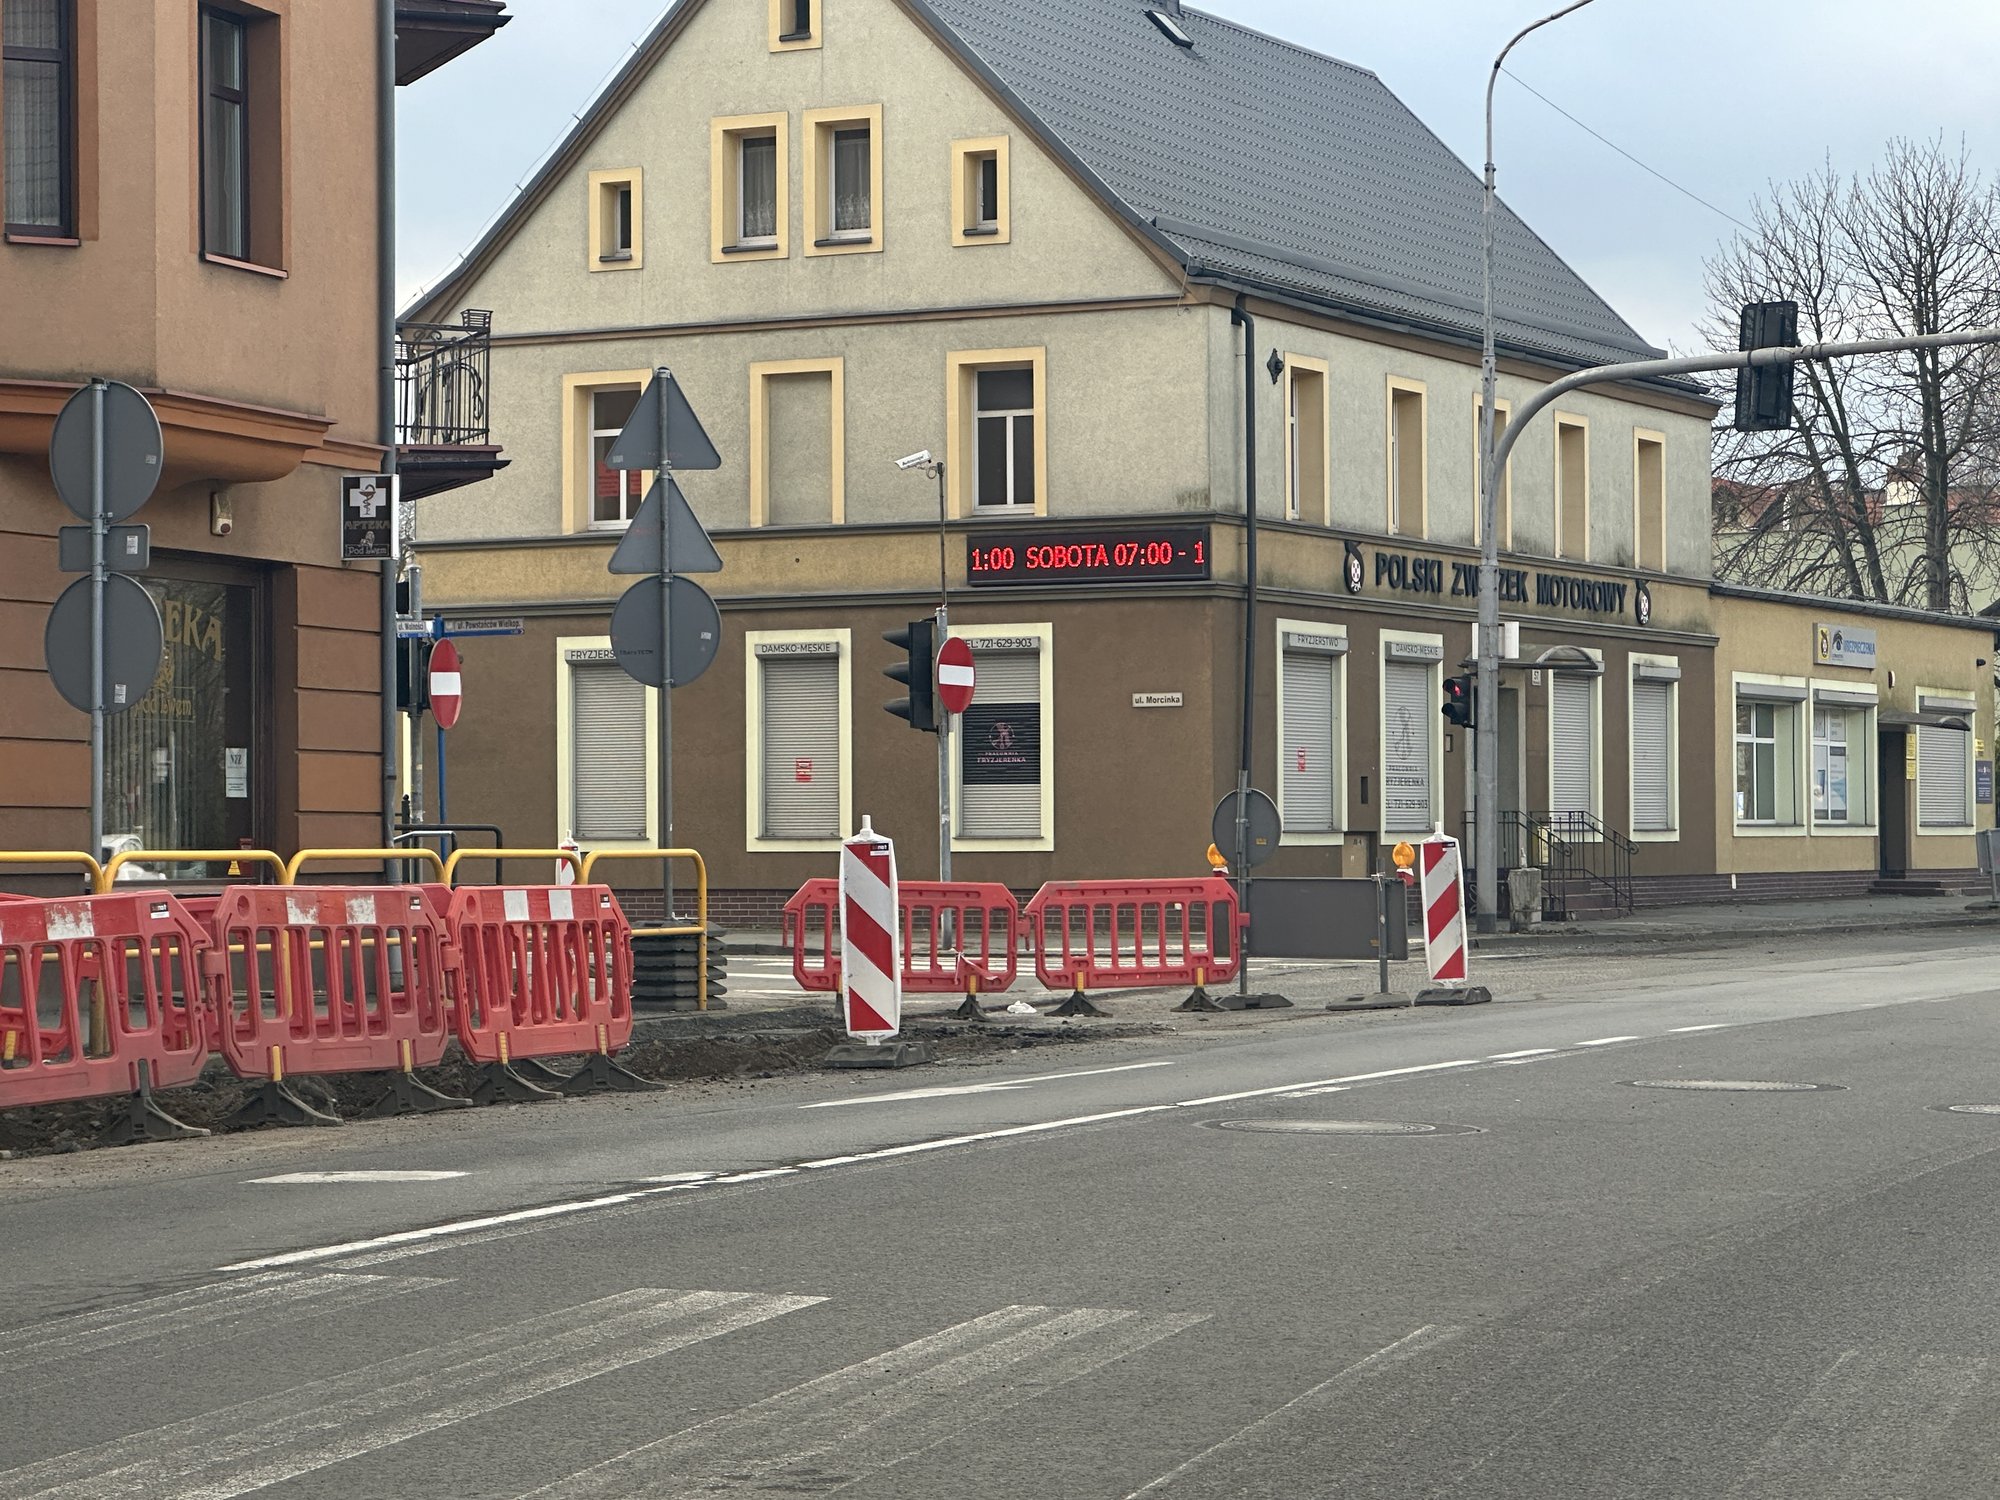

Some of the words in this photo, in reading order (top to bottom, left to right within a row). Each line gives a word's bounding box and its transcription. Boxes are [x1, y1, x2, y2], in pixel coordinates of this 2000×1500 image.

[344, 520, 391, 530] APTEKA
[348, 546, 364, 555] Pod
[972, 547, 1016, 571] 1:00
[1026, 544, 1109, 569] SOBOTA
[1114, 541, 1172, 566] 07:00
[1194, 540, 1205, 564] 1
[1375, 552, 1444, 594] POLSKI
[1452, 562, 1530, 603] ZWZEK
[1536, 572, 1628, 614] MOTOROWY
[164, 599, 222, 662] EKA
[979, 638, 1032, 648] 721-629-903
[761, 643, 831, 654] DAMSKO-MĘSKIE
[570, 650, 615, 660] FRYZJERS
[1134, 696, 1144, 704] ul.
[1145, 695, 1181, 704] Morcinka
